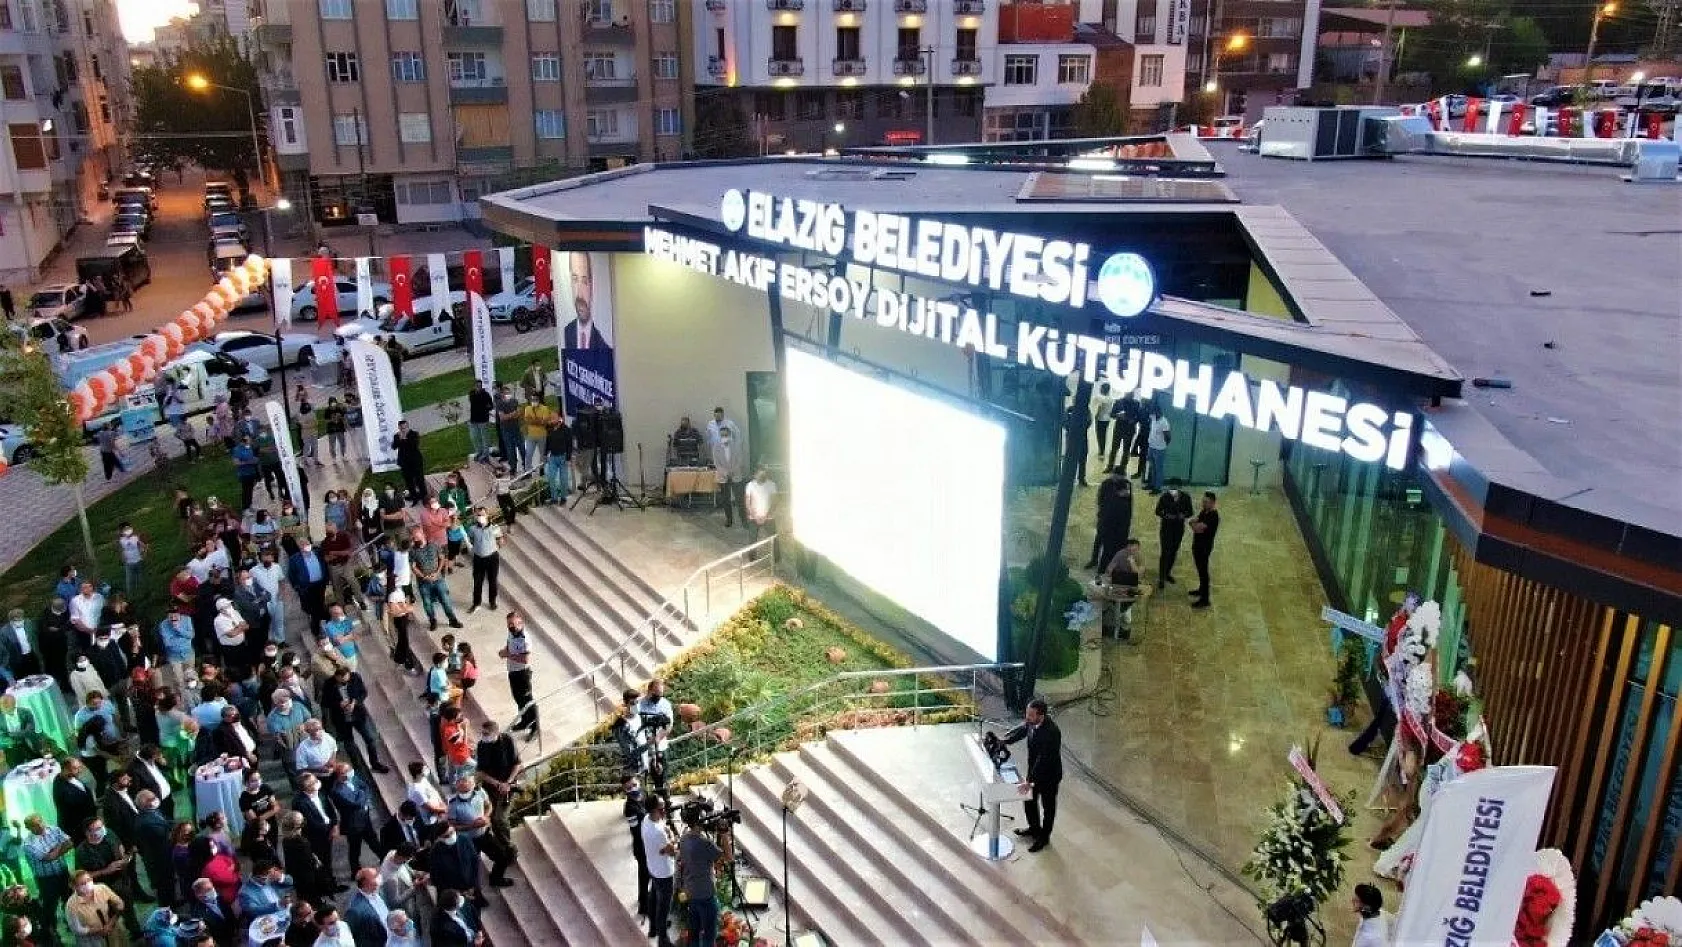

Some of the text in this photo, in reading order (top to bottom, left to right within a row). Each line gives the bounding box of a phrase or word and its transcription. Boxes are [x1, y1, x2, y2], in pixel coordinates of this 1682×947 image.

[854, 210, 1089, 308] BELEDİYESİ
[644, 226, 721, 276] MEHMET
[781, 264, 871, 319] ERSOY
[876, 286, 1007, 358] DİJİTAL
[1018, 321, 1413, 470] KÜTÜPHANESİ
[1454, 796, 1505, 912] BELEDİYESİ
